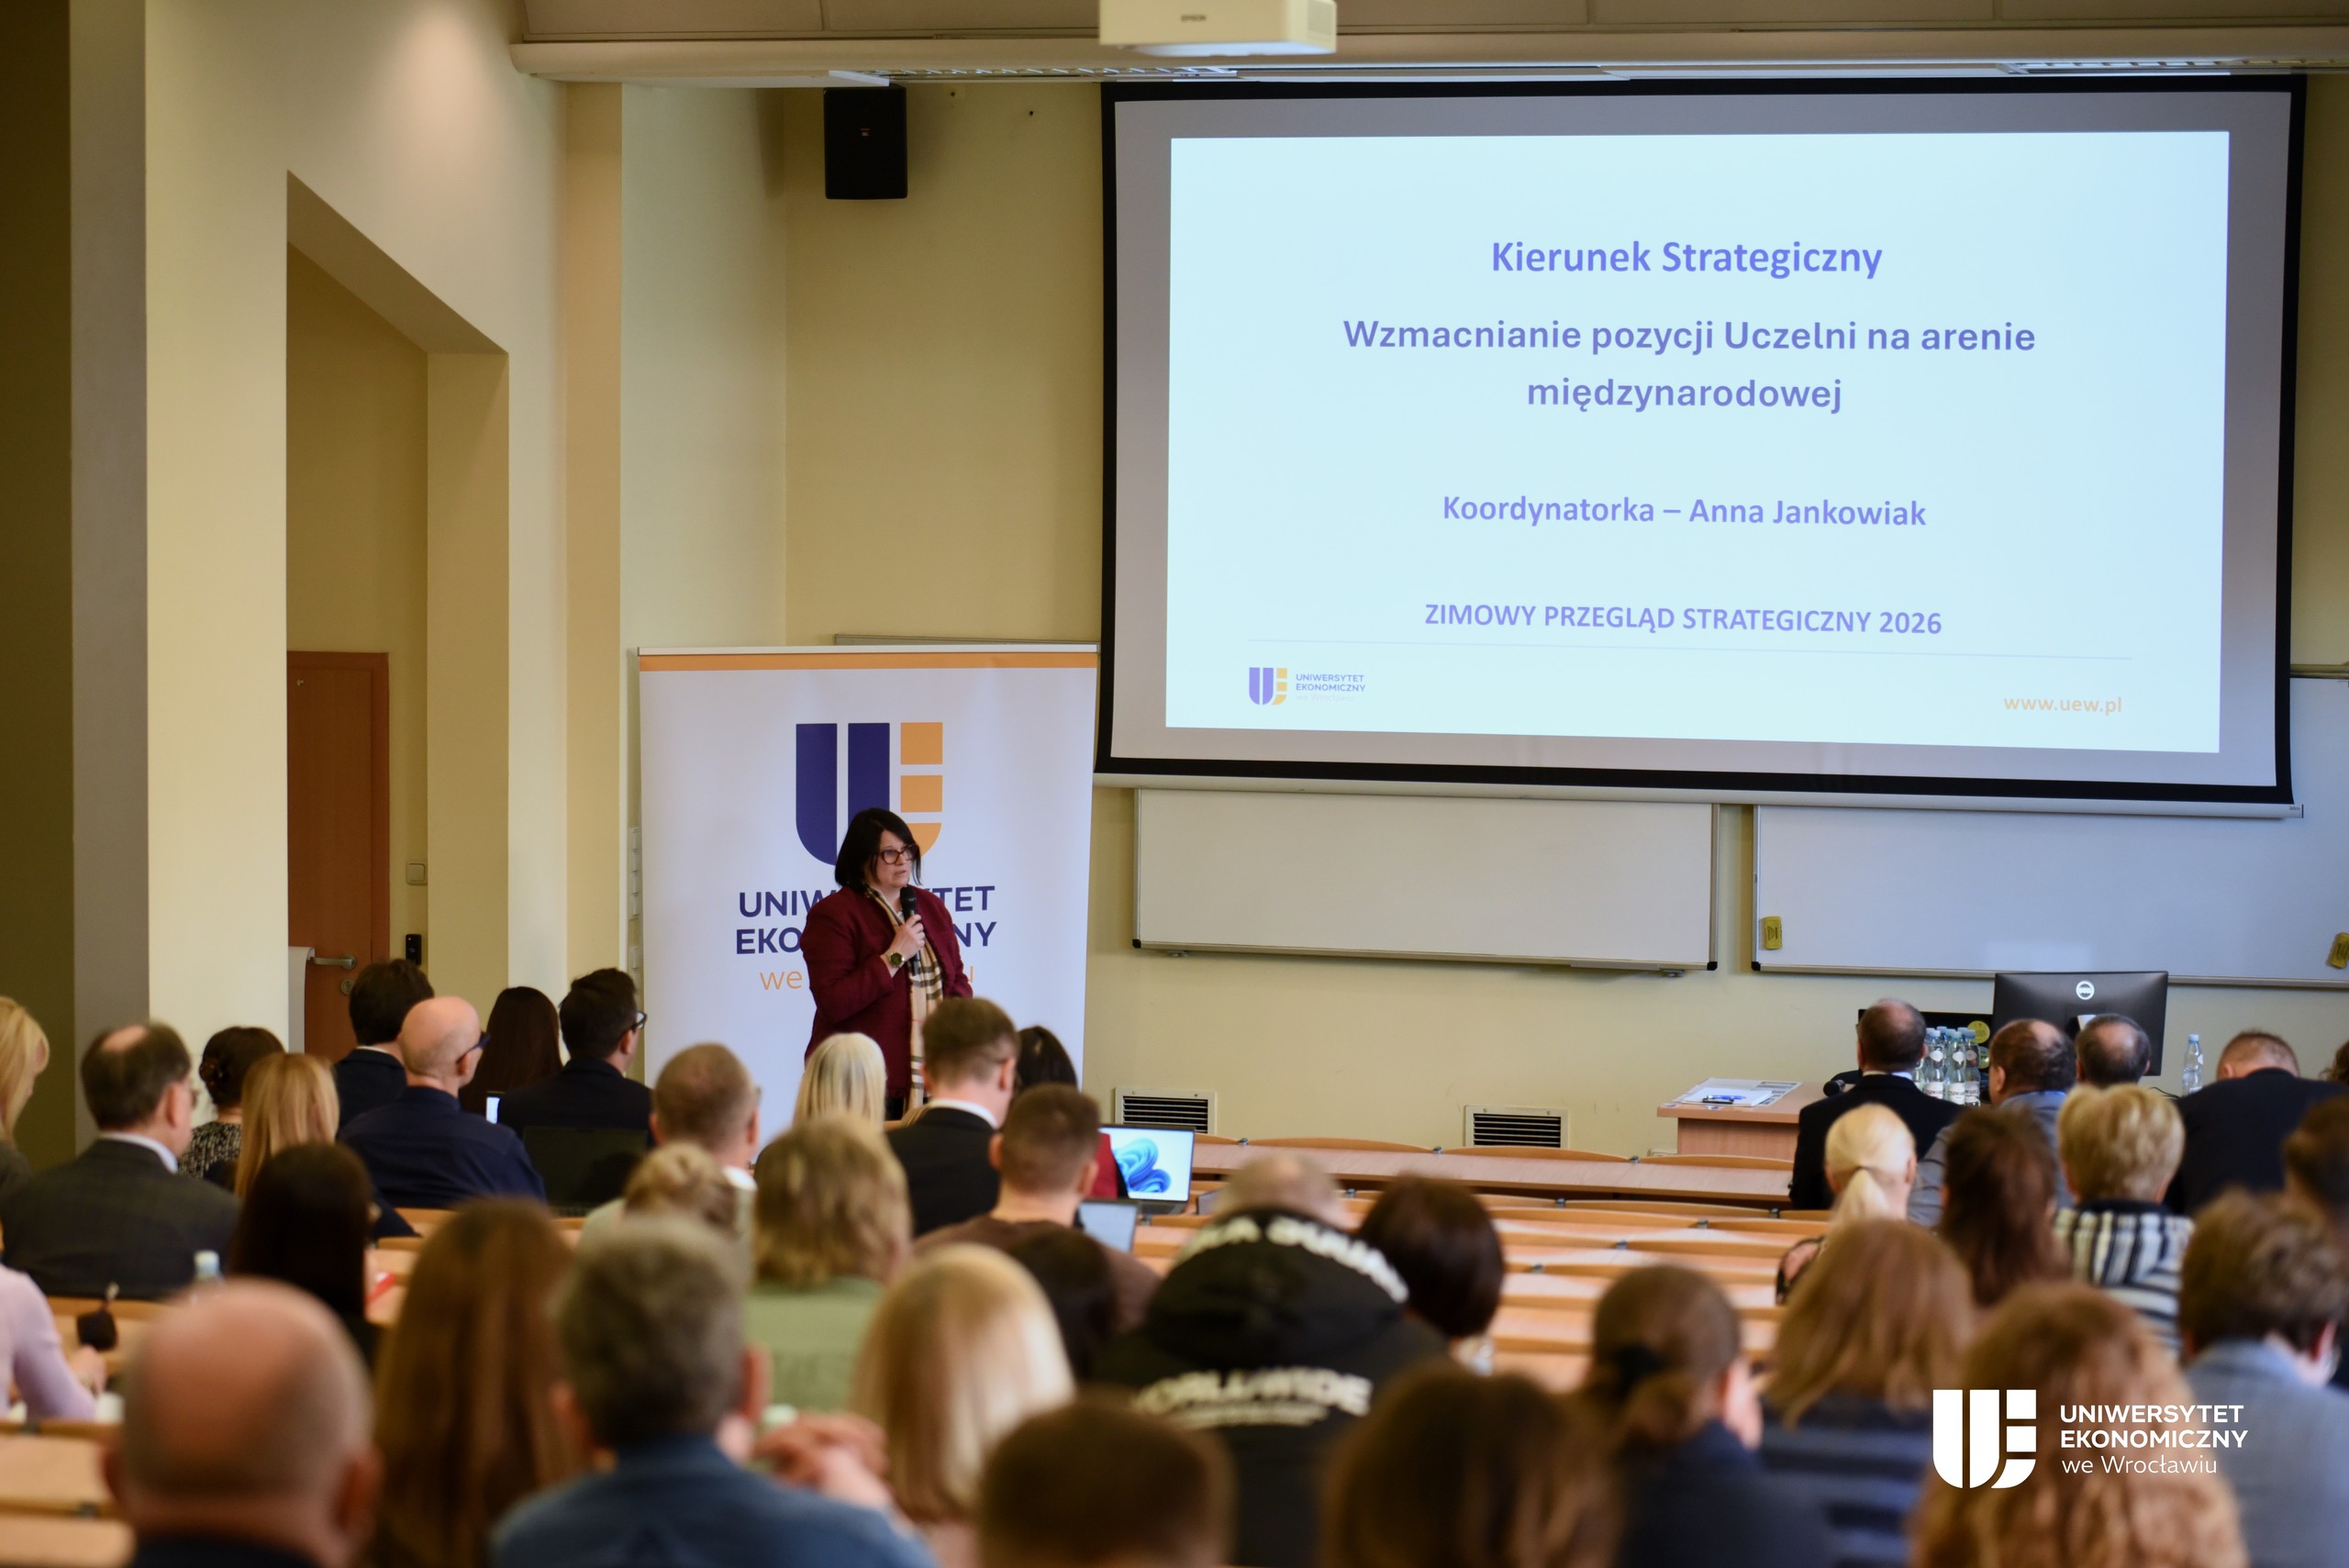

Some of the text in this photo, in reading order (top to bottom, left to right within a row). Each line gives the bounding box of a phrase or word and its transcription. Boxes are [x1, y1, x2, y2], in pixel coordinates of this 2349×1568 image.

[1492, 239, 1884, 281] Kierunek Strategiczny
[1342, 319, 2036, 357] Wzmacnianie pozycji Uczelni na arenie
[1527, 376, 1842, 415] międzynarodowej
[1443, 495, 1654, 528] Koordynatorka
[1688, 498, 1764, 524] Anna
[1772, 498, 1927, 527] Jankowiak
[1424, 603, 1943, 635] ZIMOWY PRZEGLĄD STRATEGICZNY 2026
[1296, 673, 1364, 683] UNIWERSYTET
[1296, 684, 1366, 693] EKONOMICZNY
[2003, 696, 2123, 717] www.uew.pl
[759, 969, 803, 990] we
